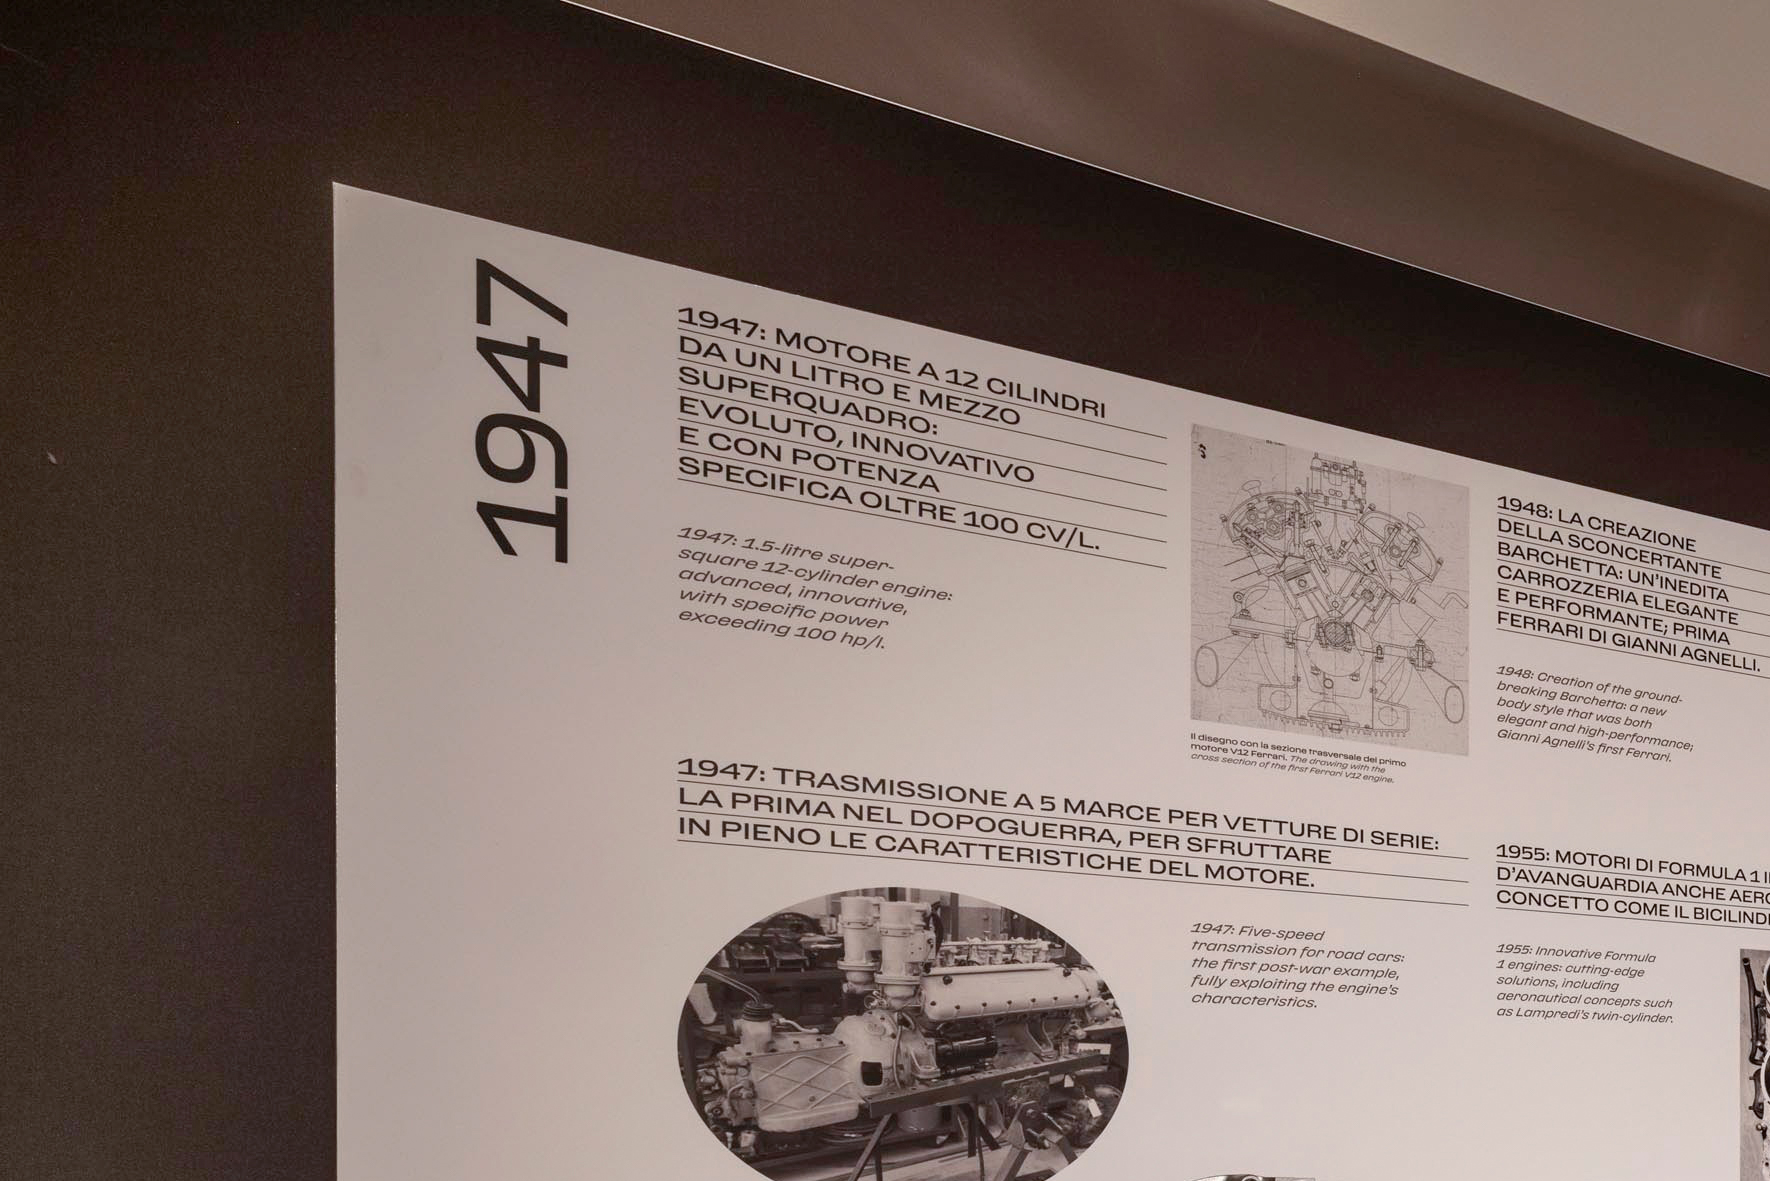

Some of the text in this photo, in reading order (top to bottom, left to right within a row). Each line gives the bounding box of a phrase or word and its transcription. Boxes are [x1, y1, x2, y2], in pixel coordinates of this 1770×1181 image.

[678, 307, 1105, 419] 1947: MOTORE A 12 CILINDRI
[679, 335, 1021, 426] DA UN LITRO E MEZZO
[475, 258, 569, 564] 1947
[678, 365, 938, 436] SUPERQUADRO:
[679, 395, 1035, 483] EVOLUTO, INNOVATIVO
[679, 425, 941, 494] E CON POTENZA
[678, 456, 1100, 551] SPECIFICA OLTRE 100 CV/L.
[1497, 495, 1697, 553] 1948: LA CREAZIONE
[676, 527, 895, 571] 1947: 1.5-litre super-
[678, 548, 953, 601] square 12-cylinder engine:
[1498, 517, 1722, 580] DELLA SCONCERTANTE
[1498, 541, 1730, 603] BARCHETTA: UN'INEDITA
[678, 569, 908, 616] advanced, innovative,
[678, 758, 1439, 851] 1947: TRASMISSIONE A 5 MARCE PER VETTURE DI SERIE:
[679, 787, 1332, 865] LA PRIMA NEL DOPOGUERRA, PER SFRUTTARE
[1496, 843, 1550, 862] 1955:
[1555, 849, 1631, 871] MOTORI
[1636, 857, 1653, 873] DI
[1658, 860, 1748, 882] FORMULA
[1749, 870, 1761, 884] 1
[1190, 922, 1326, 942] 1947: Five-speed
[1191, 940, 1405, 963] transmission for road cars:
